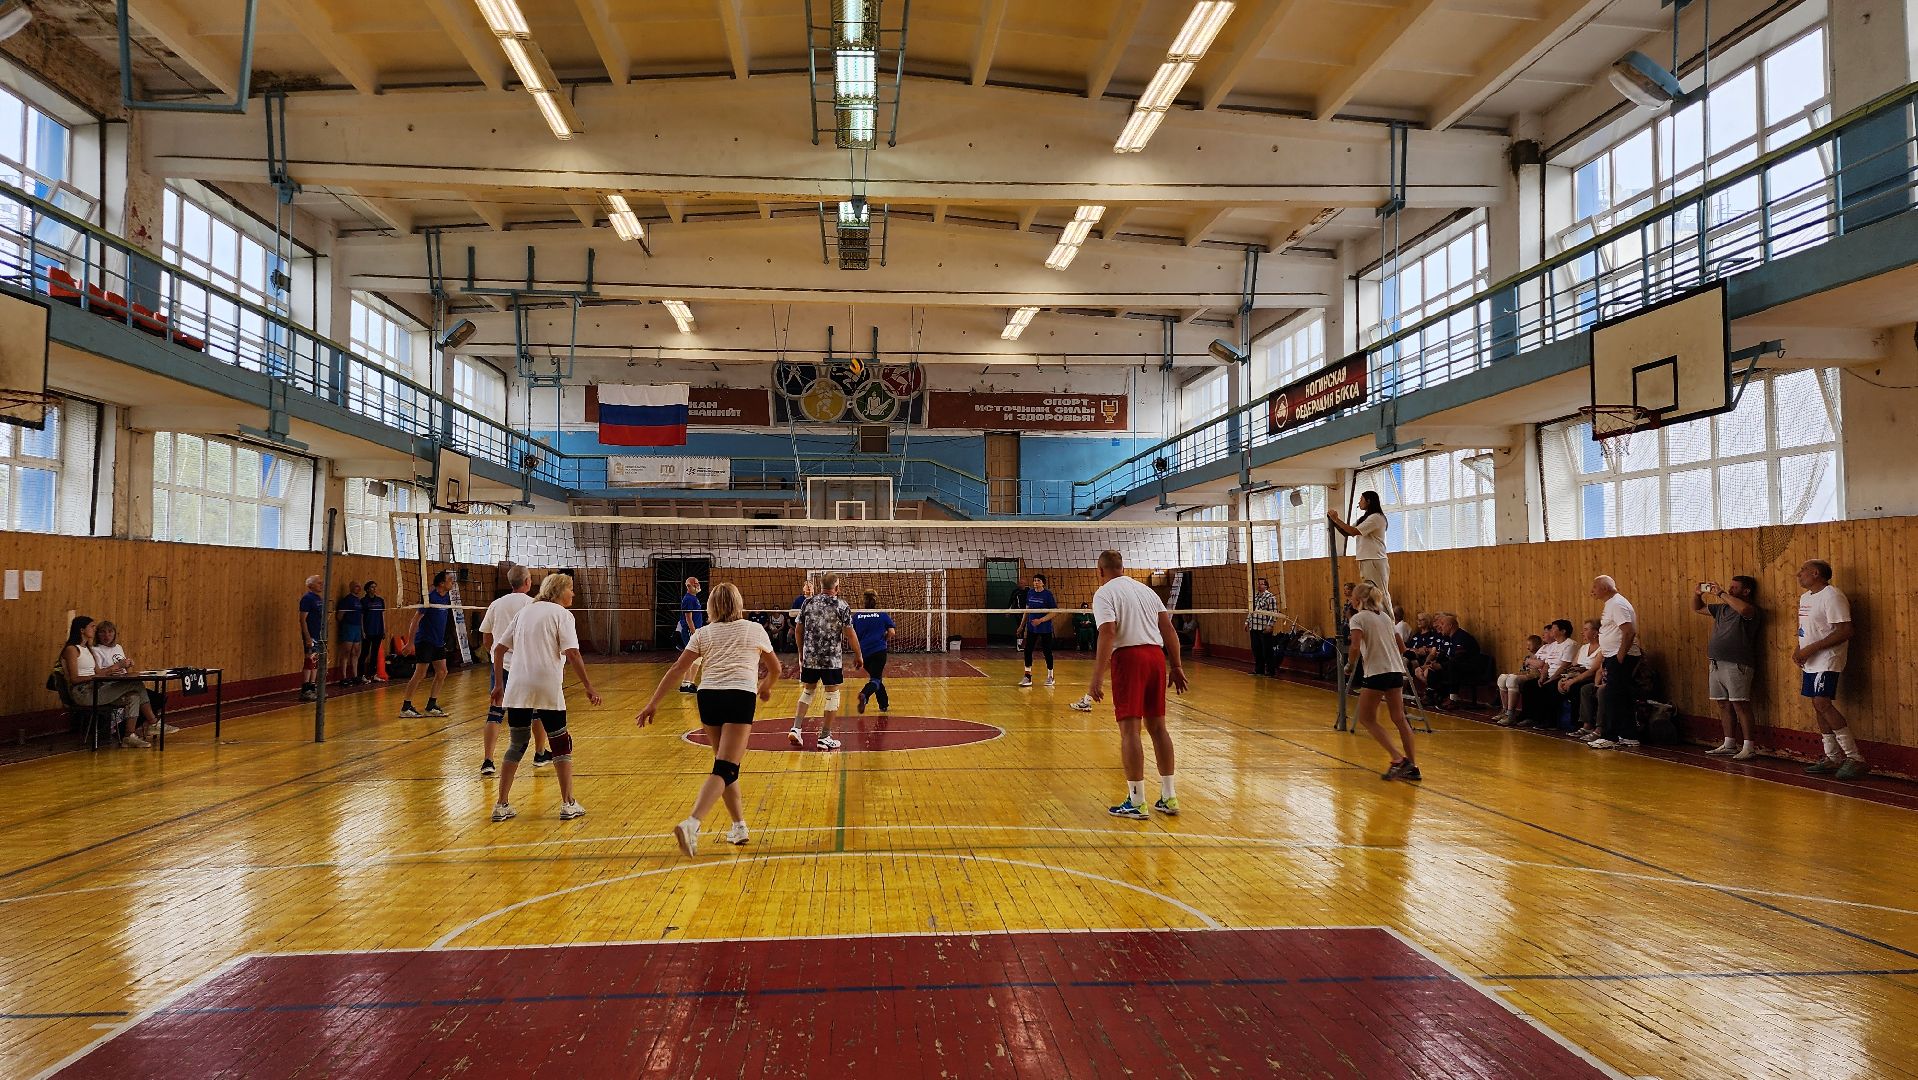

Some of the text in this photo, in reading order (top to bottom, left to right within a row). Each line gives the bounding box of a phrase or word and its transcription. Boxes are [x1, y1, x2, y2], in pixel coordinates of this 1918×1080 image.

[1305, 366, 1347, 398] НОГИНСКАЯ
[974, 404, 1096, 414] ИСТОЧНИК СИЛЫ
[1295, 391, 1334, 420] ФЕДЕРАЦИЯ
[1003, 413, 1095, 422] И ЗДОРОВЬЯ!
[660, 464, 675, 474] ГТО
[185, 675, 191, 691] 9
[197, 674, 204, 688] 4
